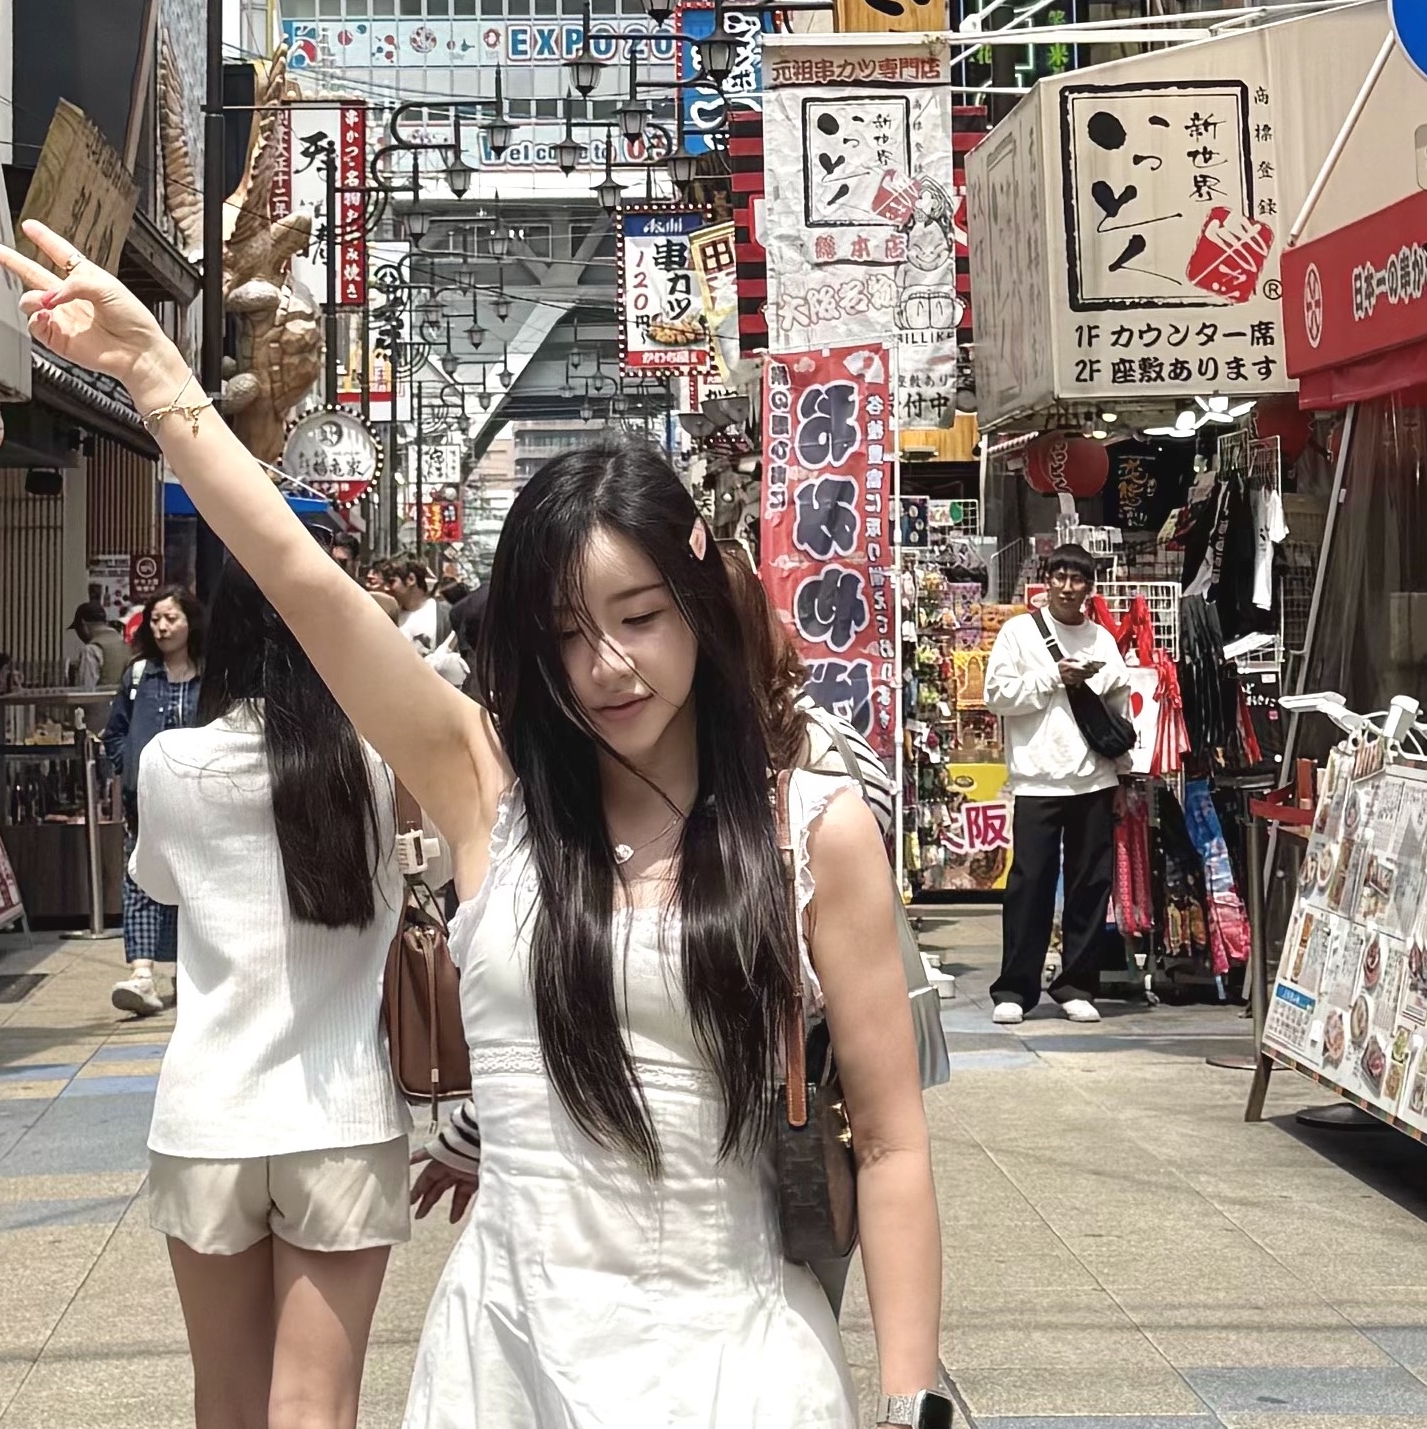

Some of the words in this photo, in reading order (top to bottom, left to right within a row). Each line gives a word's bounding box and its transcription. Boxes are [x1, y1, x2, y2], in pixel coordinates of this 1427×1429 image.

[509, 27, 616, 59] EXPO
[772, 58, 940, 82] 元祖串カツ専門店
[1184, 112, 1228, 203] 新世界
[653, 239, 691, 320] 串カツ
[1076, 326, 1100, 348] 1F
[1111, 320, 1275, 348] カウンター席
[1076, 359, 1101, 382] 2F
[1111, 355, 1278, 383] 座敷あります
